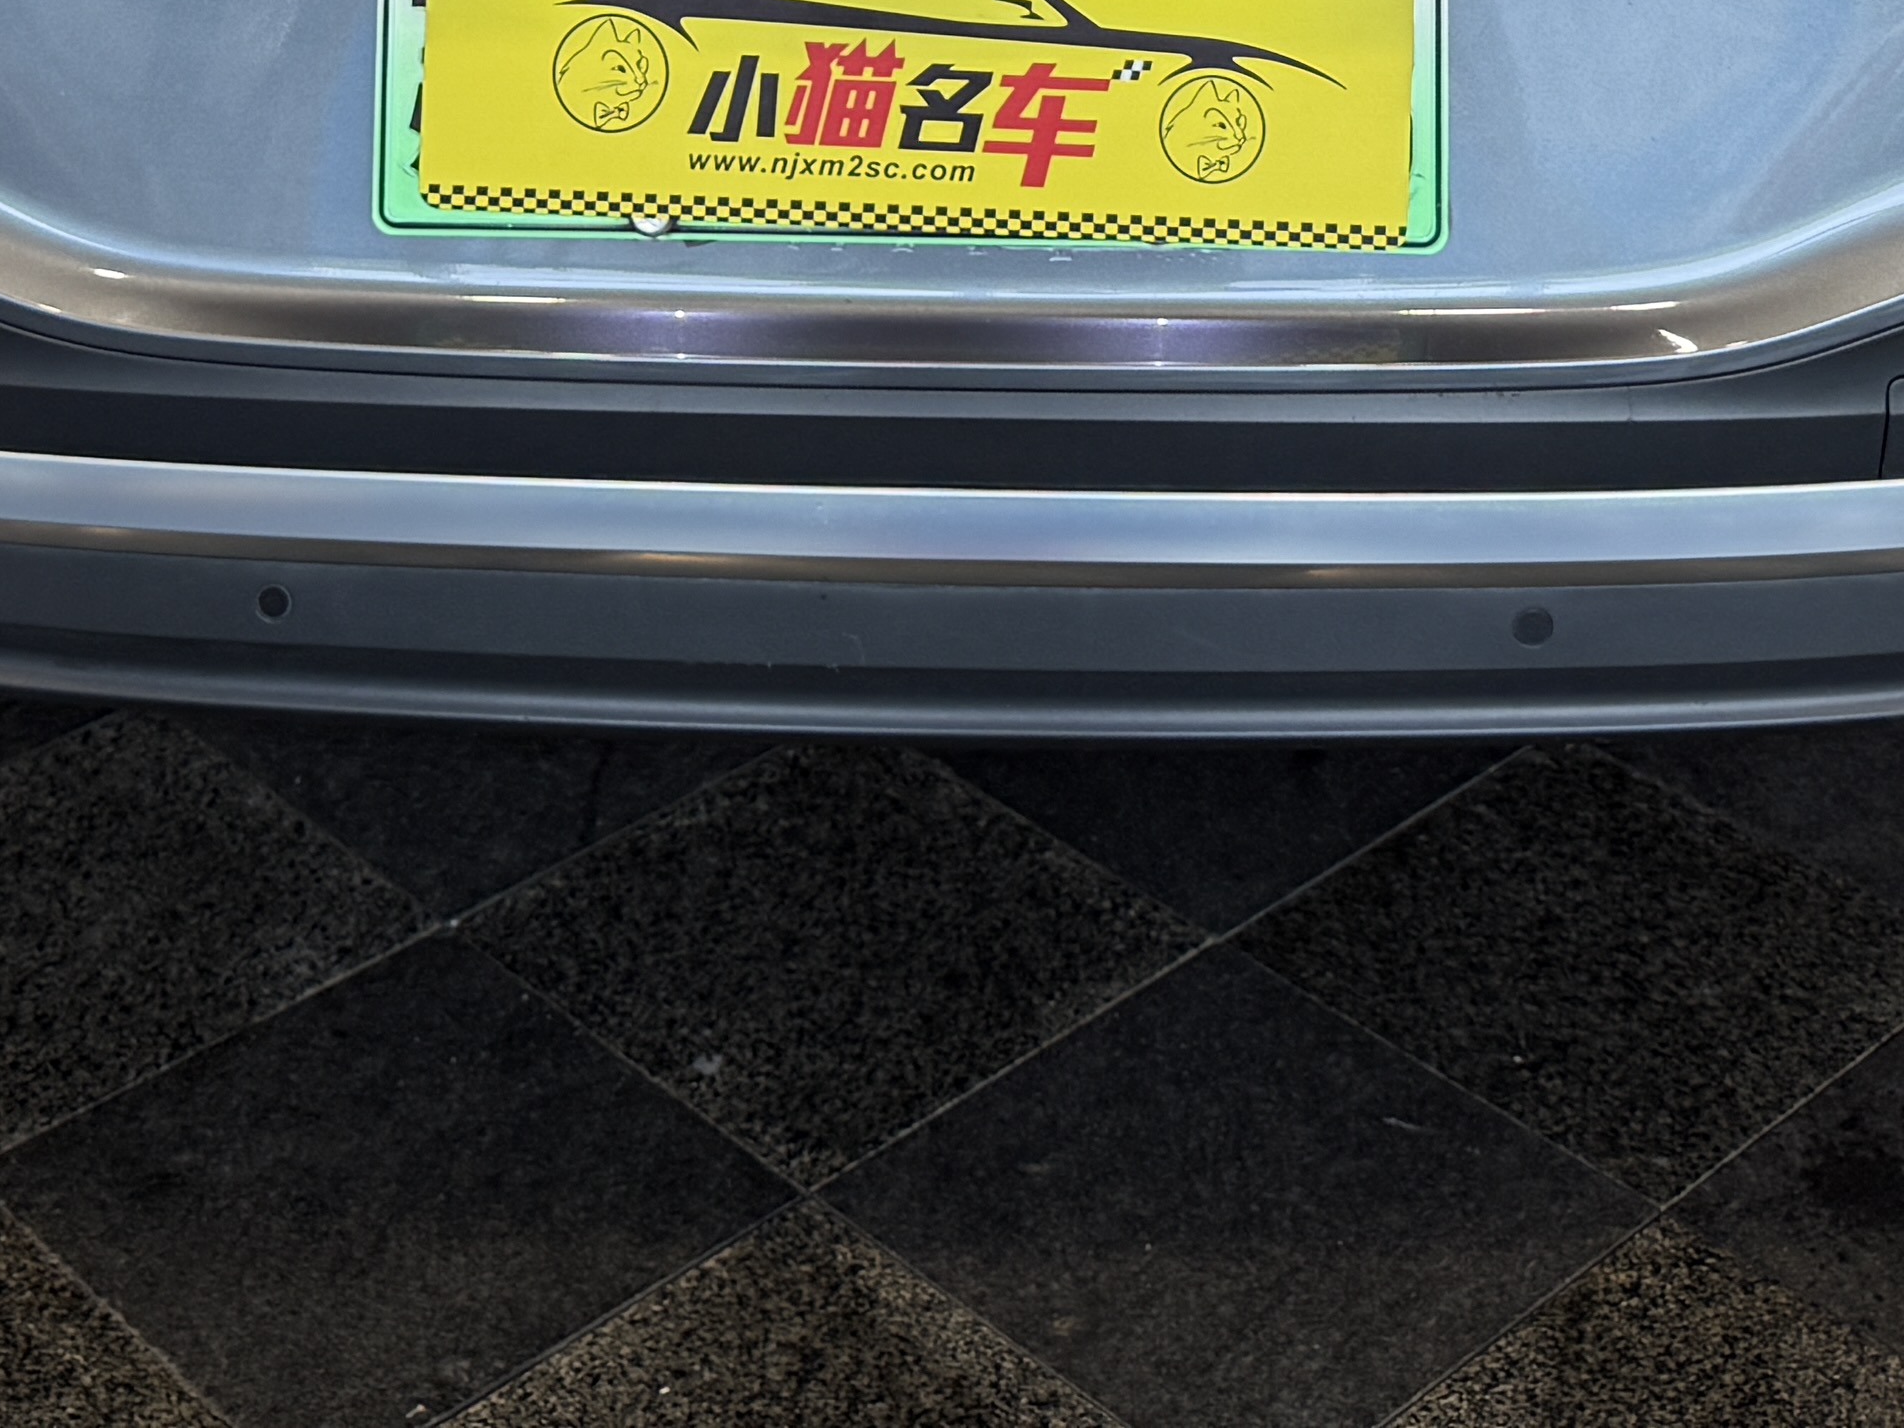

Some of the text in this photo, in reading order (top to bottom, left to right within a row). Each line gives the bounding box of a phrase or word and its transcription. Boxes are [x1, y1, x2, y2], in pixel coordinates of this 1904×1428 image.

[687, 38, 1111, 187] 小猫名车
[688, 151, 976, 183] www.njxm2sc.com
